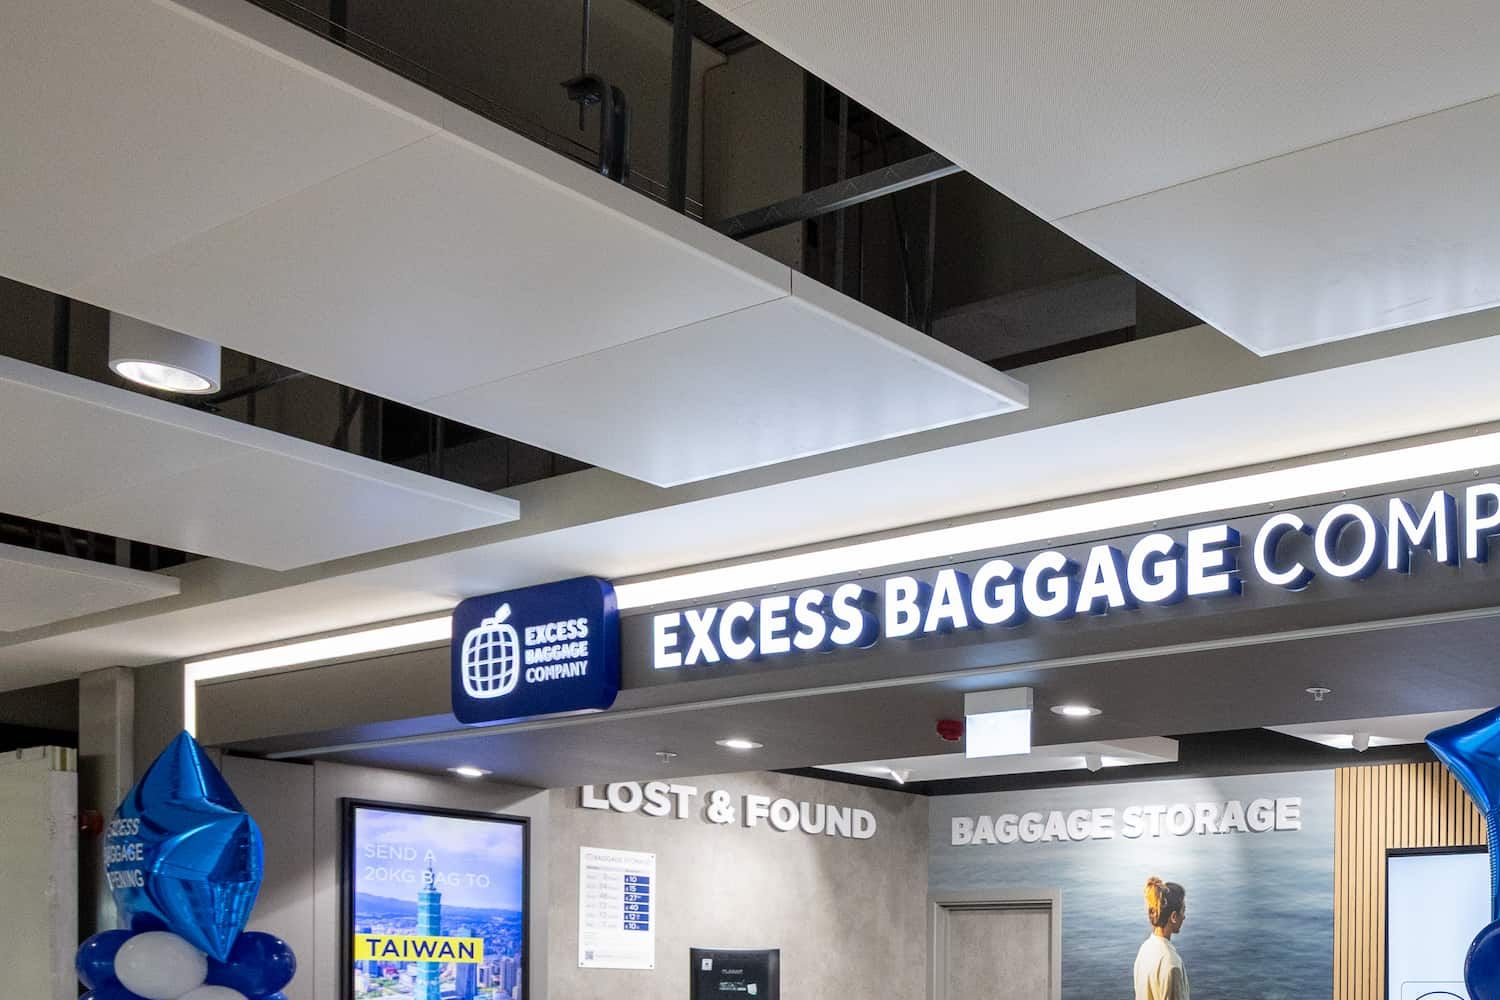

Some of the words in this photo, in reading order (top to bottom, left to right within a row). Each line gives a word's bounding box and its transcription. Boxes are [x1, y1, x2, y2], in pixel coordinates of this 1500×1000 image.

[653, 582, 870, 669] EXCESS
[885, 524, 1233, 639] BAGGAGE
[525, 617, 588, 646] EXCESS
[525, 641, 588, 665] BAGGAGE
[525, 660, 588, 683] COMPANY
[581, 781, 697, 819] LOST
[706, 790, 735, 824] &
[744, 794, 877, 839] FOUND
[951, 807, 1115, 847] BAGGAGE
[1121, 797, 1301, 839] STORAGE
[364, 843, 417, 860] SEND
[424, 849, 437, 862] A
[365, 866, 416, 883] 20KG
[423, 870, 461, 887] BAG
[465, 873, 491, 888] TO
[366, 938, 475, 959] TAIWAN
